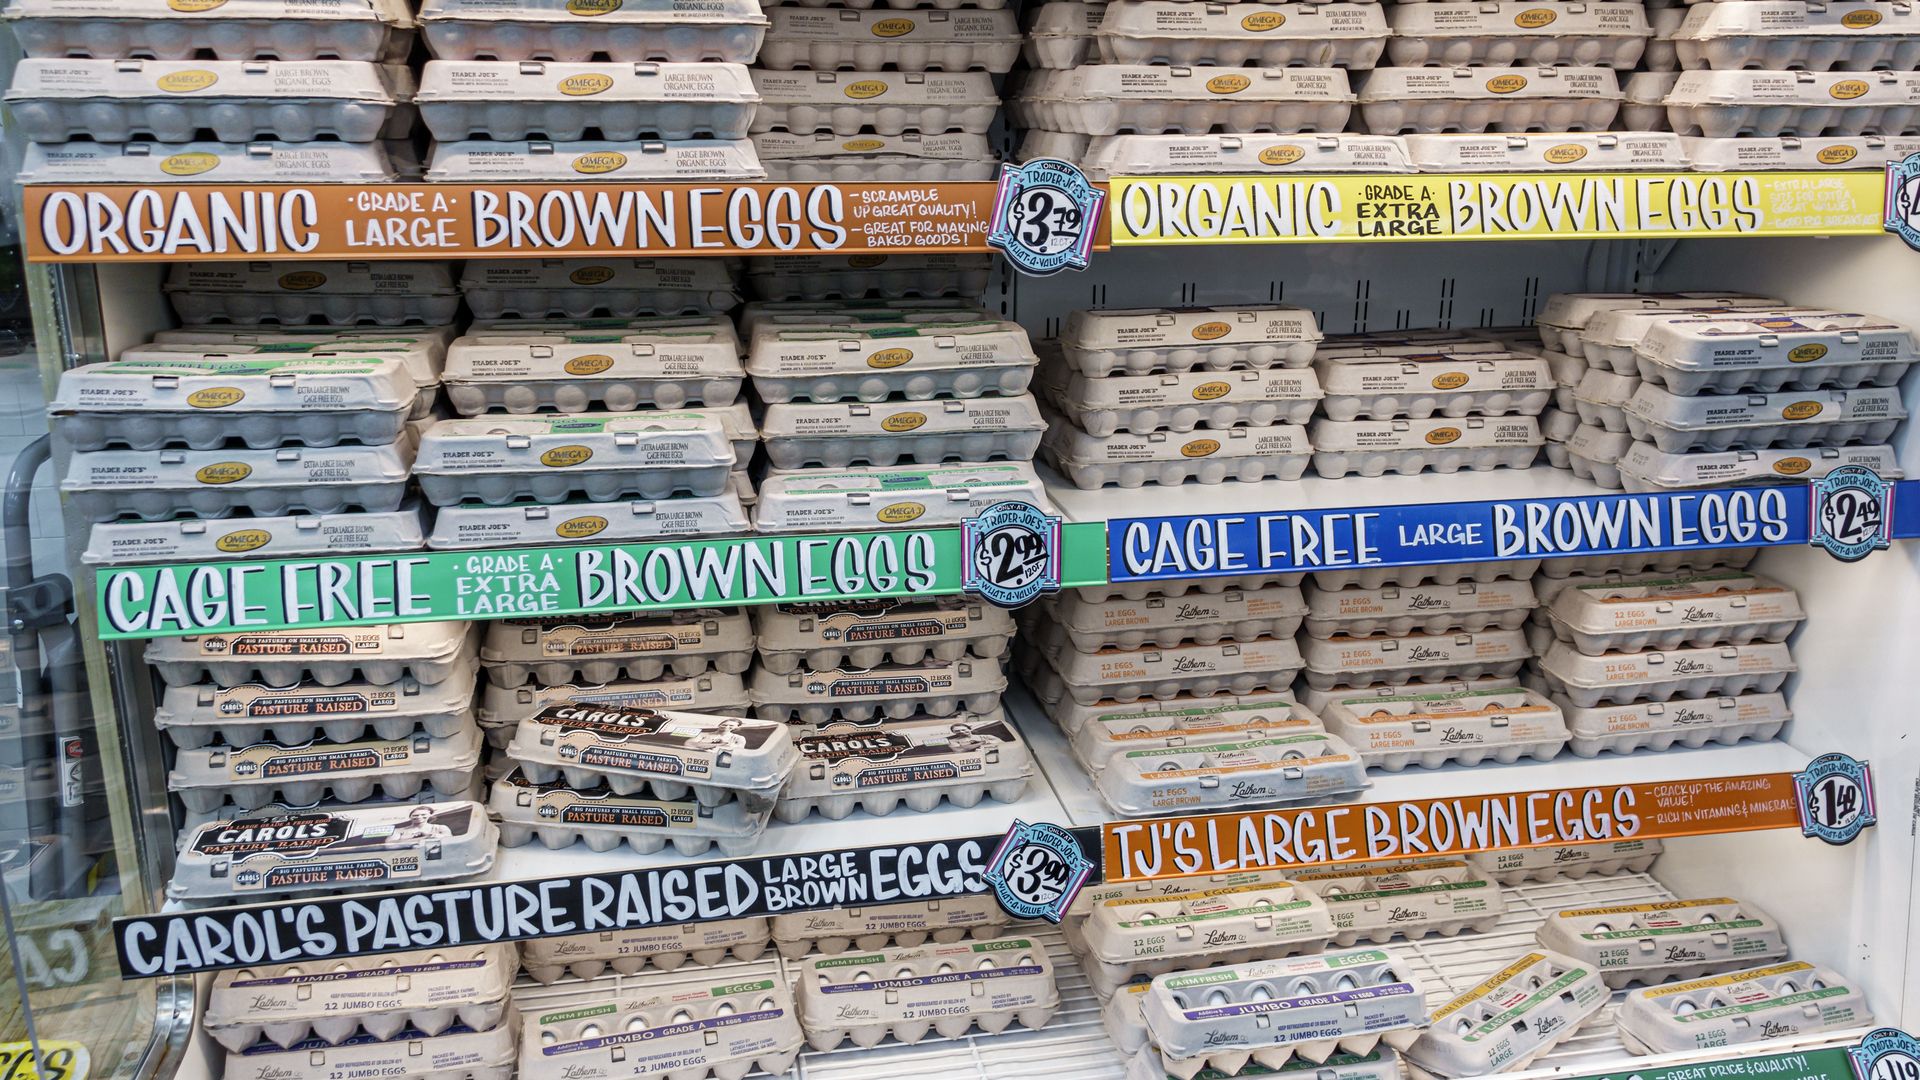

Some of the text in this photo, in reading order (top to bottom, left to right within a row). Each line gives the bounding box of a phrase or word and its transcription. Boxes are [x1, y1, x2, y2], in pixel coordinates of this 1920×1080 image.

[566, 77, 610, 88] OMEGA 3
[664, 73, 714, 82] LARGE BROWN
[664, 82, 715, 91] ORGANIC EGGS
[853, 200, 977, 218] UP GREAT QUALITY!
[1121, 180, 1343, 238] ORGANIC
[1447, 176, 1626, 236] BROWN
[1635, 177, 1765, 233] EGGS
[1357, 202, 1440, 220] EXTRA
[41, 189, 320, 255] ORGANIC
[472, 189, 677, 249] BROWN
[689, 184, 847, 250] EGGS
[910, 221, 934, 234] FOR
[936, 220, 989, 234] MAKING
[1357, 219, 1442, 236] LARGE
[346, 216, 461, 248] LARGE
[867, 234, 912, 247] BAKED
[571, 360, 603, 368] OMEGA
[1122, 489, 1789, 576] CAGE FREE LARGE BROWN EGGS
[104, 565, 269, 633] CAGE
[280, 557, 433, 624] FREE
[576, 541, 786, 607] BROWN
[797, 533, 937, 595] EGGS
[457, 573, 561, 594] EXTRA
[457, 593, 560, 615] LARGE
[1682, 606, 1714, 621] Lathem
[850, 625, 940, 640] PASTURE RAISED
[237, 642, 347, 654] PASTURE RAISED
[254, 701, 363, 715] PASTURE RAISED
[556, 707, 650, 727] CAROL'S
[586, 754, 679, 774] PASTURE RAISED
[862, 769, 954, 786] PASTURE RAISED
[1166, 788, 1187, 796] EGGS
[1230, 781, 1266, 799] Lathem
[1689, 785, 1702, 796] UP
[1704, 782, 1723, 794] THE
[1724, 778, 1771, 792] AMAZING
[1152, 796, 1201, 807] LARGE BROWN
[1656, 795, 1694, 808] VALUE!
[1681, 811, 1693, 822] IN
[1694, 804, 1741, 821] VITAMINS
[1749, 797, 1797, 814] MINERALS
[216, 823, 332, 845] CAROL'S
[1112, 786, 1642, 880] TJ'S LARGE BROWN EGGS
[271, 872, 328, 885] PASTURE
[335, 868, 385, 880] RAISED
[399, 856, 419, 864] EGGS
[763, 851, 857, 884] LARGE
[766, 873, 870, 911] BROWN
[124, 904, 337, 975] CAROL'S
[341, 879, 576, 955] PASTURE
[582, 862, 759, 929] RAISED
[868, 840, 986, 900] EGGS
[1600, 958, 1628, 966] LARGE
[1611, 949, 1629, 957] EGGS
[1665, 946, 1697, 962] Lathem
[1169, 953, 1376, 988] FARM FRESH EGGS
[725, 982, 762, 994] EGGS
[1239, 994, 1341, 1015] JUMBO GRADE A
[597, 1022, 706, 1047] JUMBO GRADE A
[1204, 1028, 1343, 1045] Lathem 12 JUMBO EGGS
[1709, 1063, 1745, 1077] PRICE
[1755, 1056, 1811, 1074] QUALITY!
